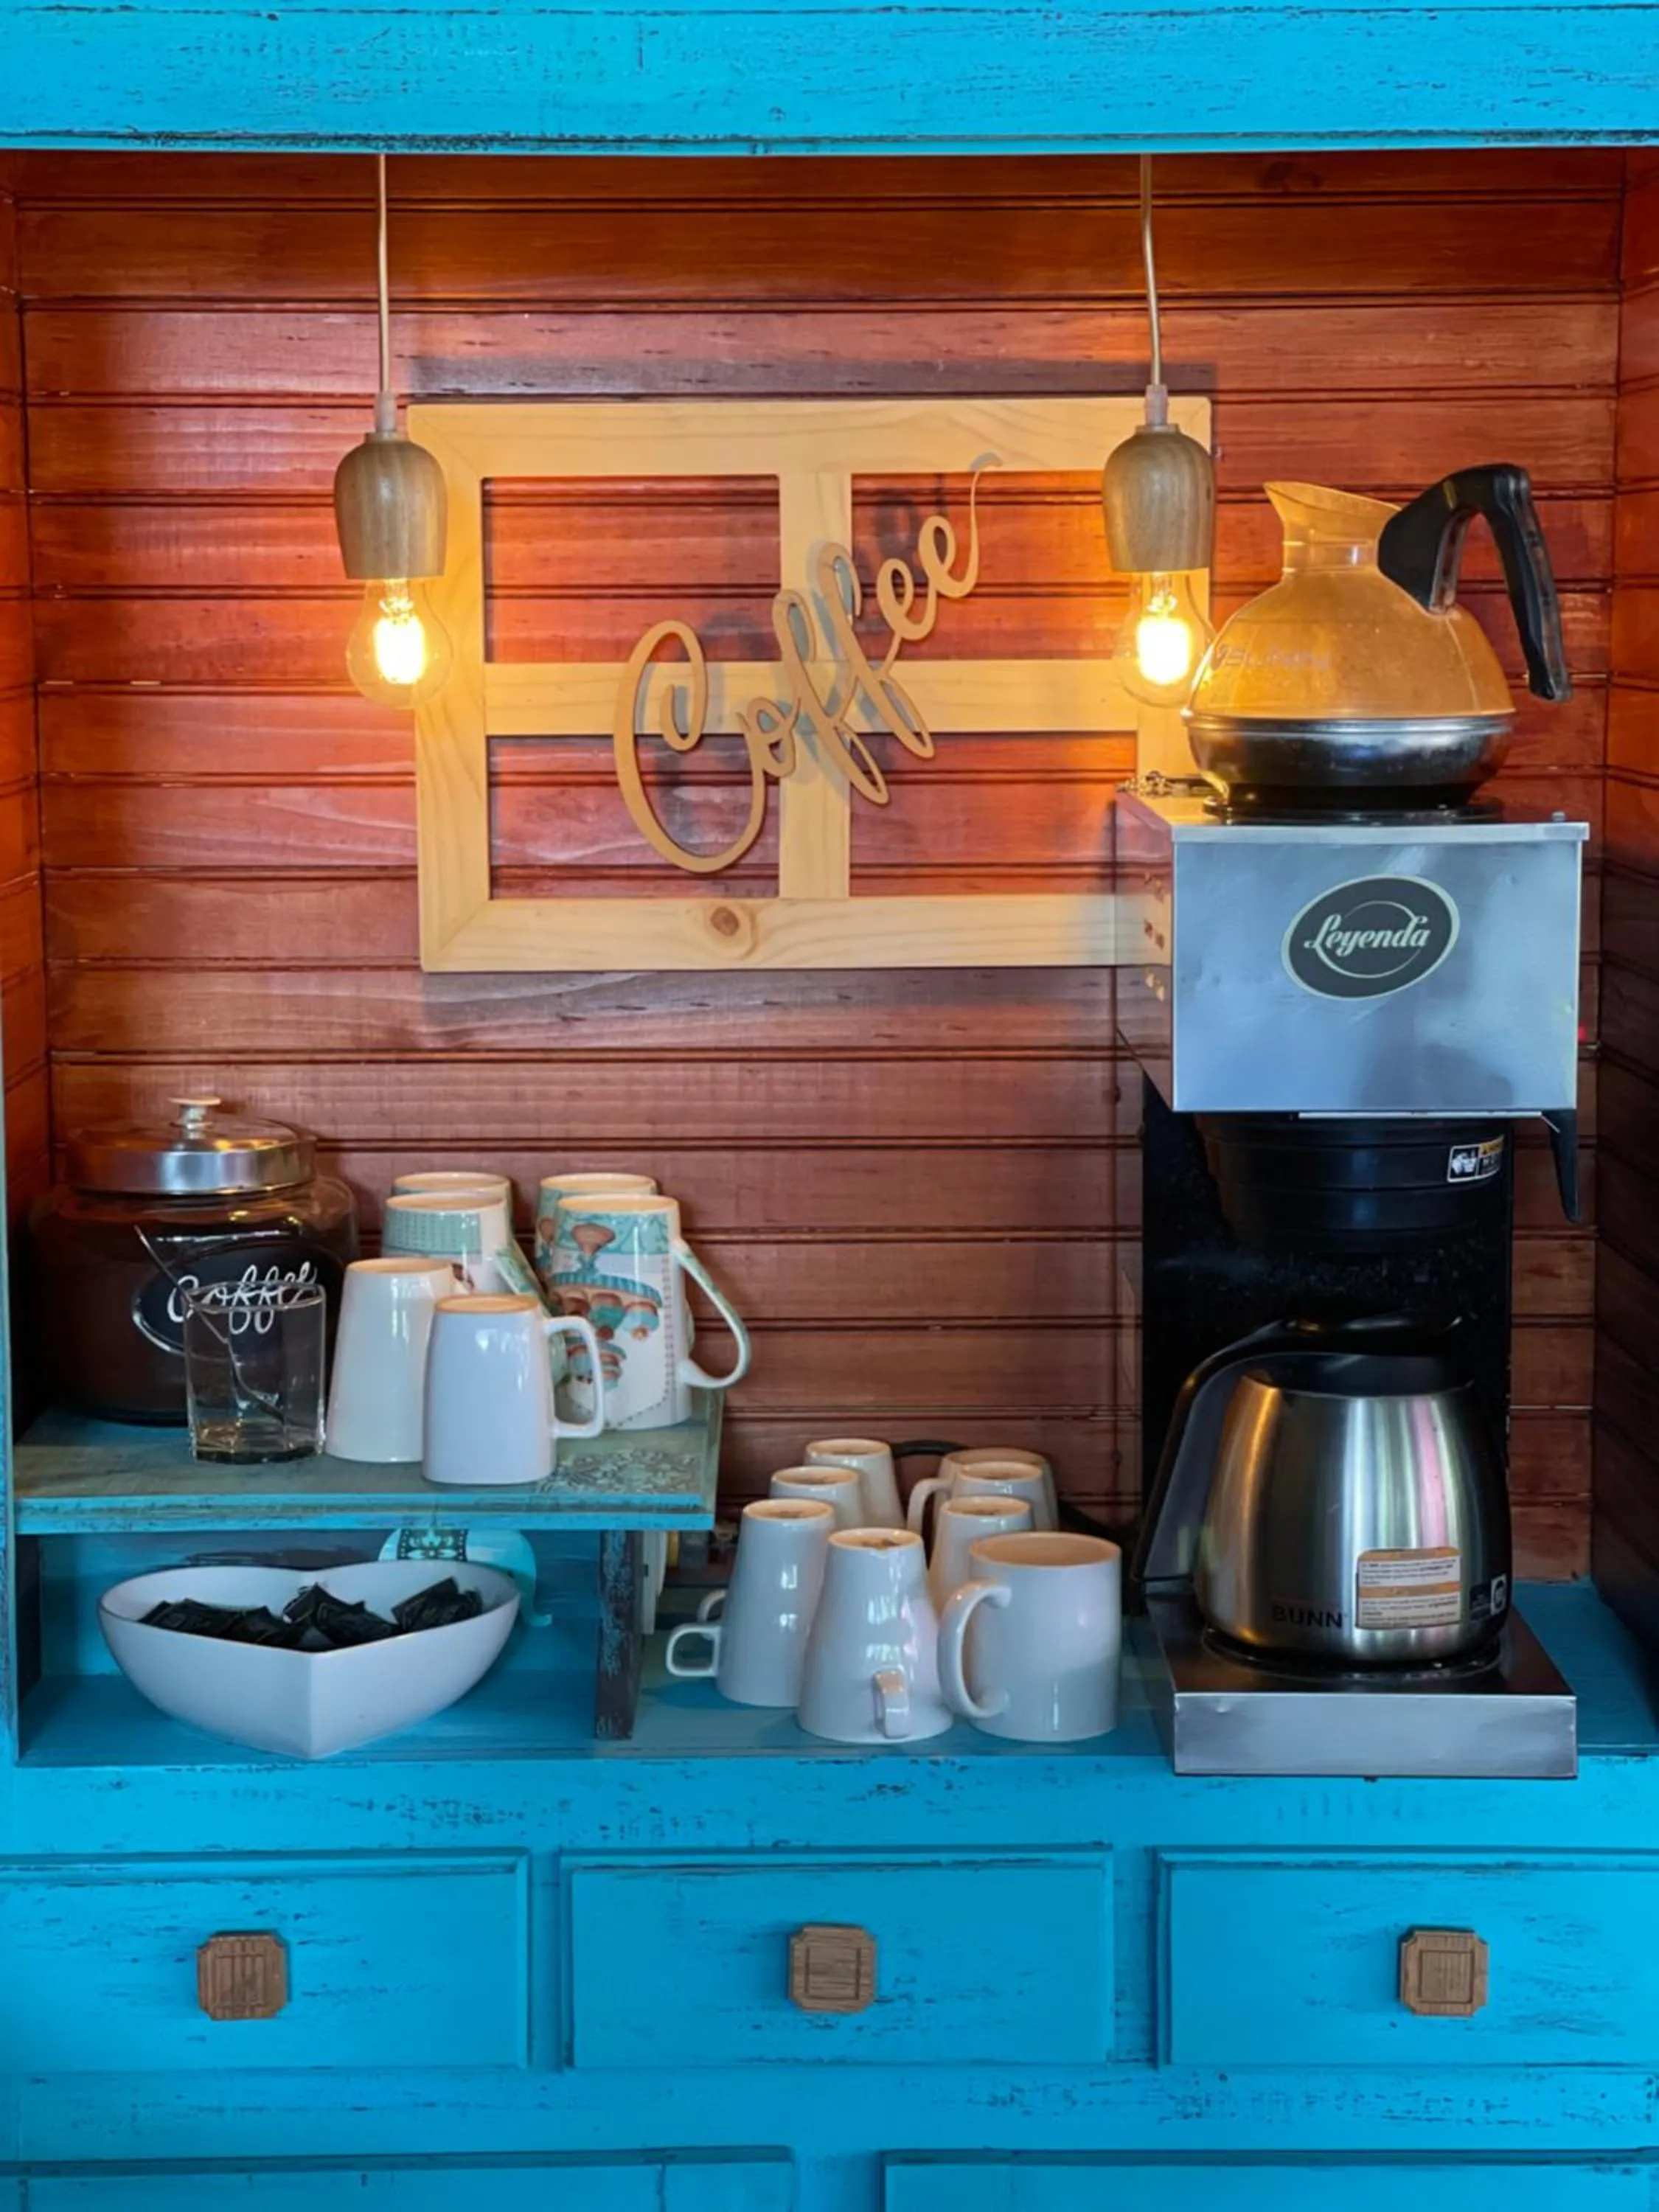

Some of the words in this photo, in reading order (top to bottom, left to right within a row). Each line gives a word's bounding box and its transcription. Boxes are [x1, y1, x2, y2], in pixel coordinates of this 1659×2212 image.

[613, 452, 1002, 874] Coffee
[1304, 914, 1430, 957] Leyenda
[167, 1261, 318, 1335] Coffee
[1272, 1604, 1343, 1629] BUNN
